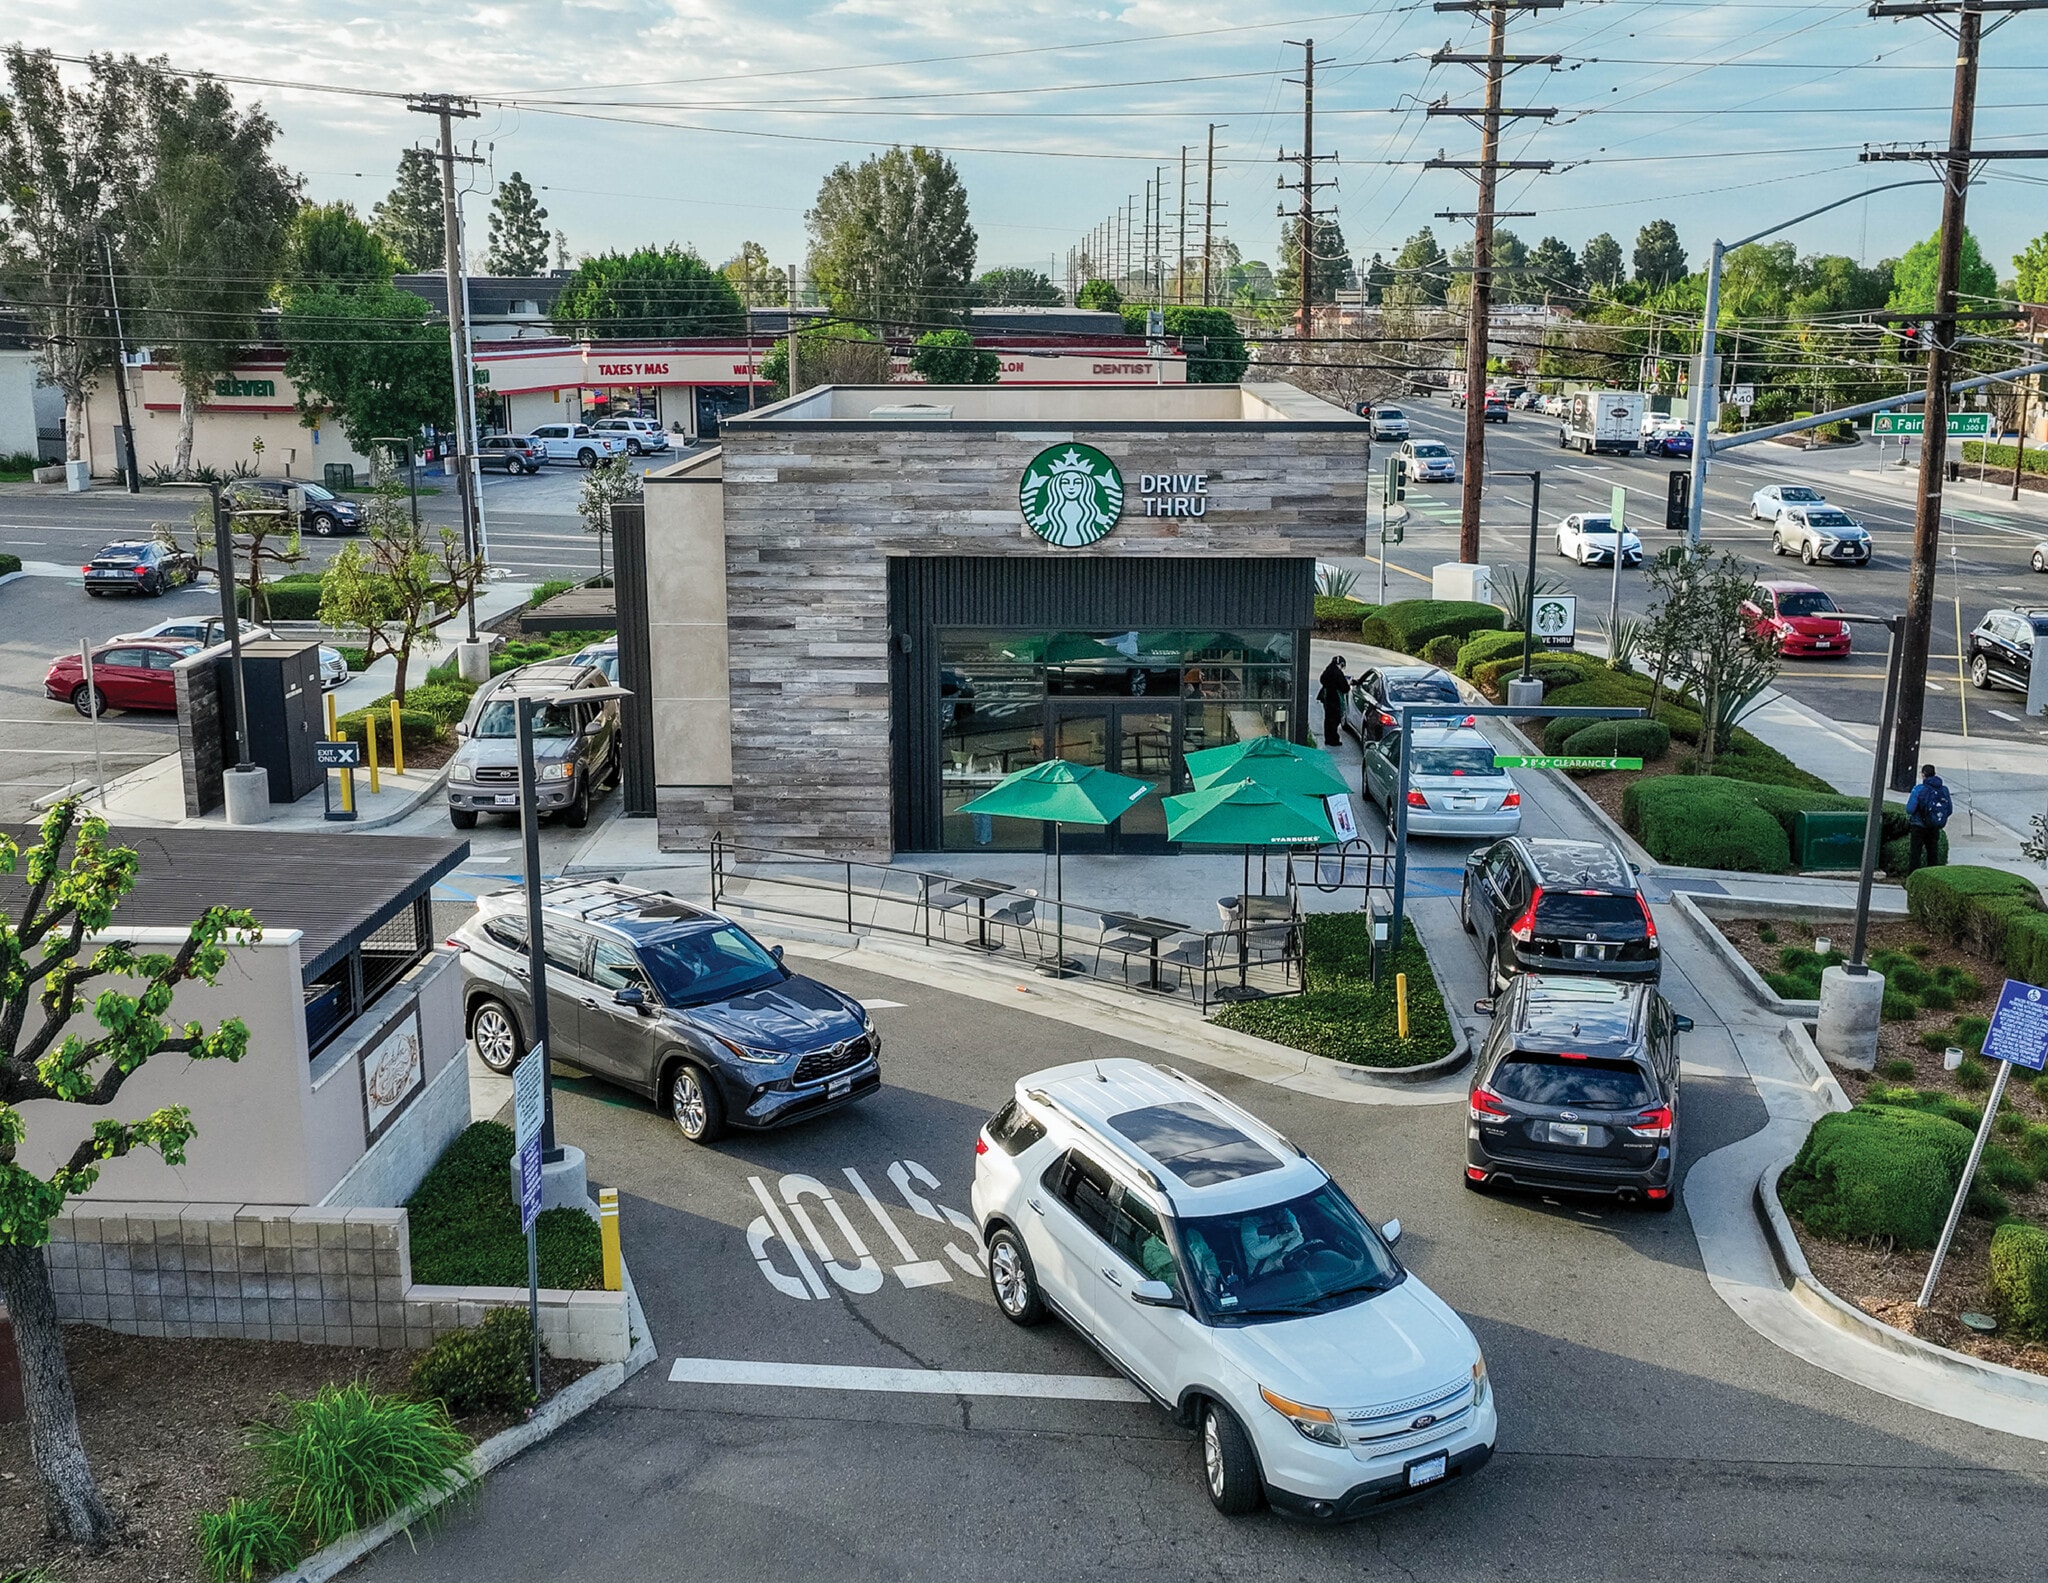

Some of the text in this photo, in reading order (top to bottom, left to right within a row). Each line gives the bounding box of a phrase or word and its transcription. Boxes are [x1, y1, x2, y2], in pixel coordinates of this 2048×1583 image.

[599, 363, 669, 375] TAXES Y MAS
[1000, 362, 1024, 372] LON
[1093, 363, 1153, 374] DENTIST
[1738, 394, 1752, 403] 40
[1897, 418, 1959, 431] Fairen
[1140, 474, 1208, 494] DRIVE
[1142, 497, 1207, 517] THRU
[1552, 636, 1572, 644] THRU
[1553, 758, 1607, 768] CLEARANCE
[746, 1159, 990, 1300] STOP
